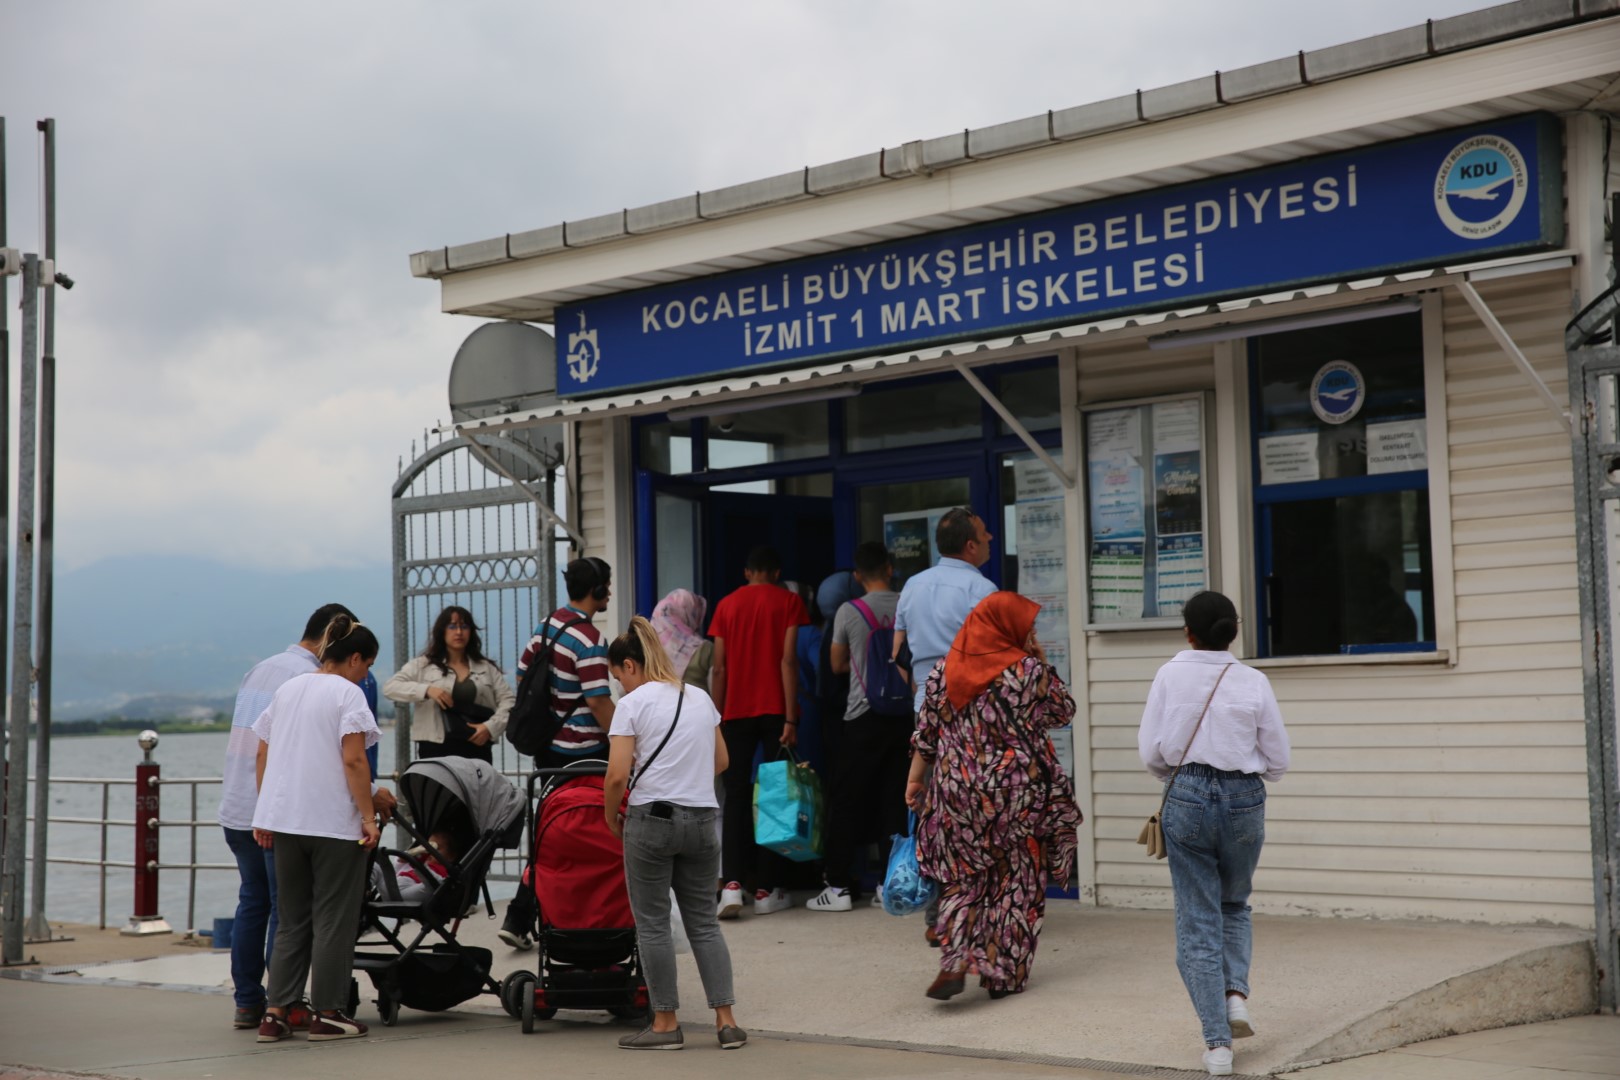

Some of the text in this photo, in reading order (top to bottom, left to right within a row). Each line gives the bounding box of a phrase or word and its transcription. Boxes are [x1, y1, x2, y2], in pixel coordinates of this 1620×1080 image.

[1460, 161, 1498, 179] KDU
[642, 165, 1357, 333] KOCAELİ BÜYÜKŞEHİR BELEDİYESİ
[744, 242, 1204, 356] İZMİT 1 MART İSKELESİ
